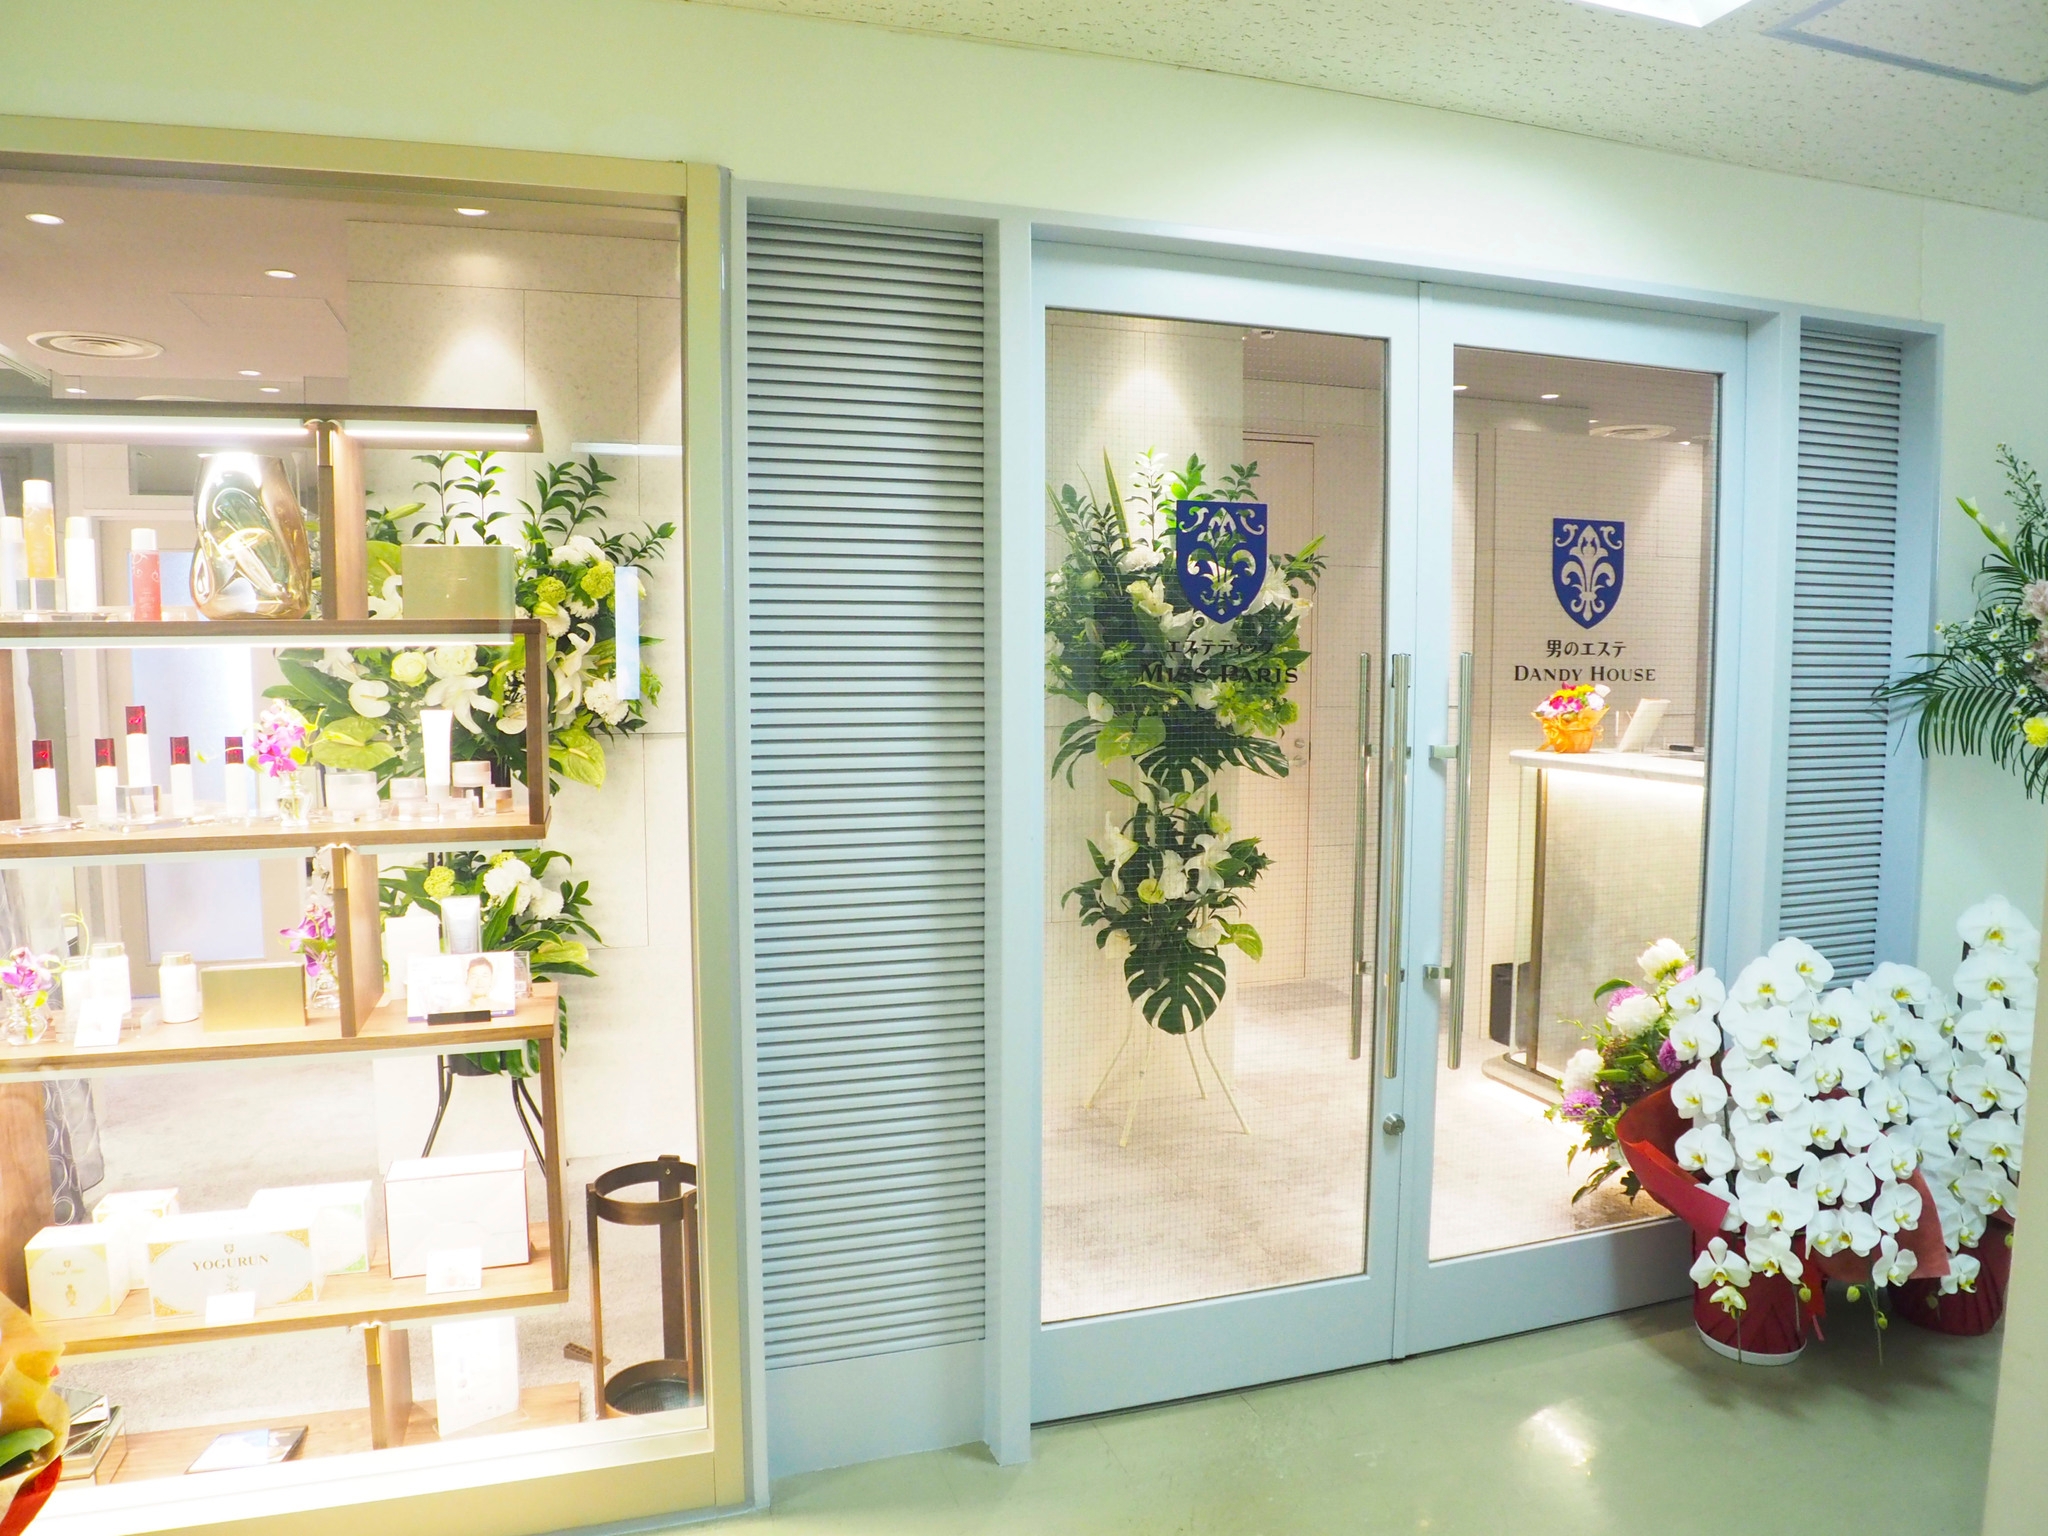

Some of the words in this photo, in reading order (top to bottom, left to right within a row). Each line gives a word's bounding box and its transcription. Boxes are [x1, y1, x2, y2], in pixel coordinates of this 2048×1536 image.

[1546, 639, 1626, 658] 男のエステ
[1221, 663, 1298, 683] PARIS
[1514, 665, 1583, 682] DANDY
[1591, 665, 1656, 682] HOUSE
[192, 1254, 269, 1271] YOGURUN
